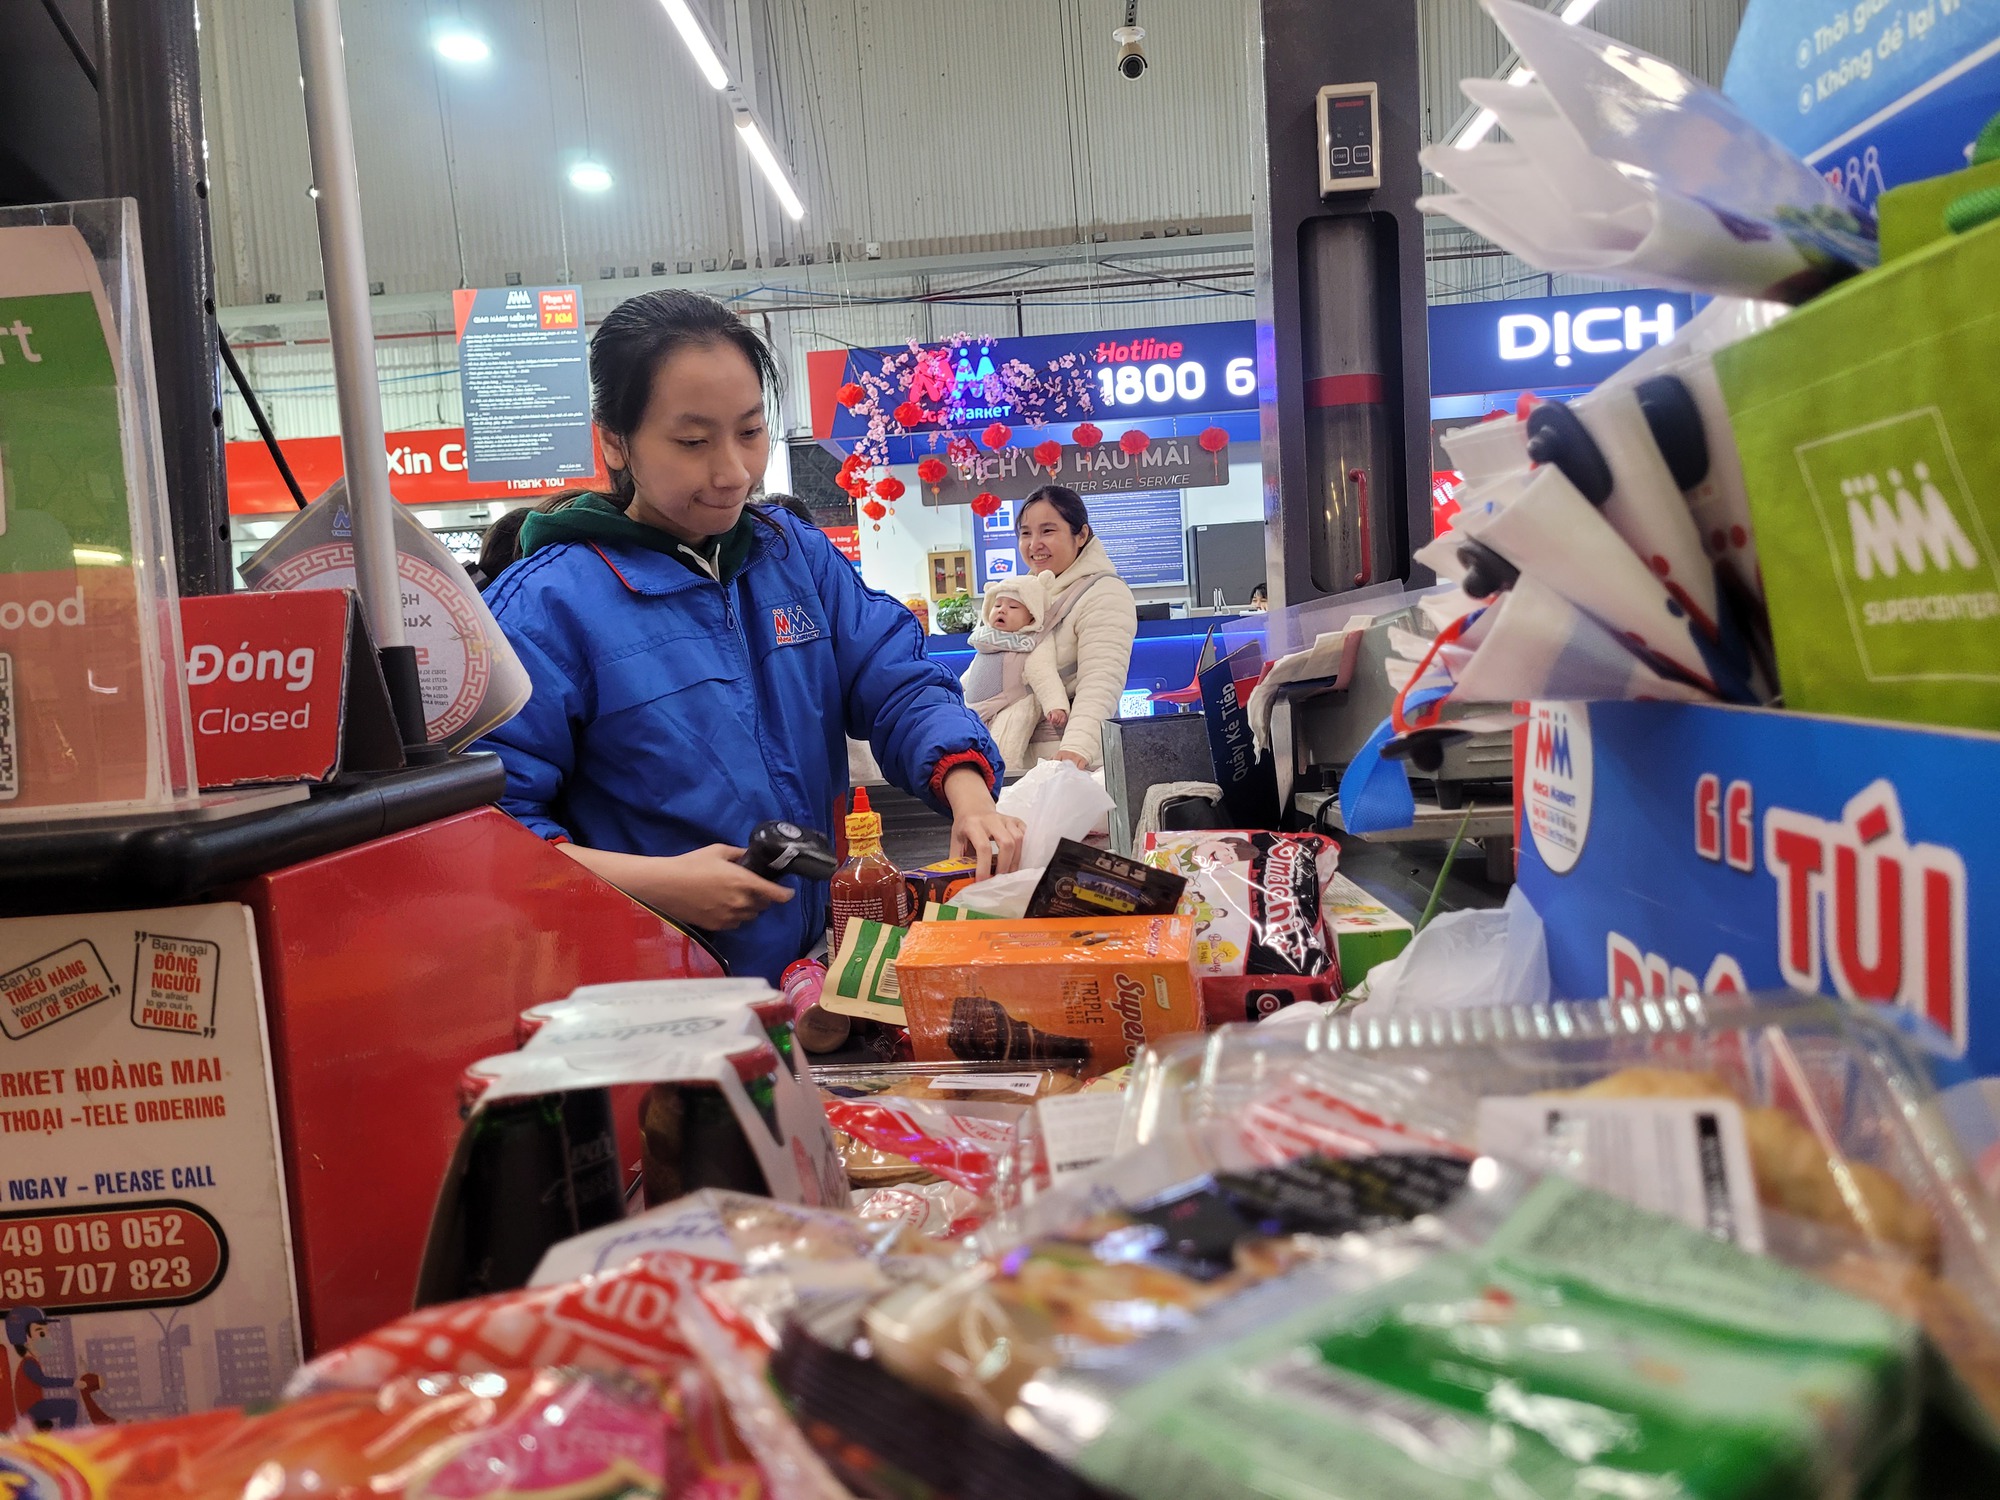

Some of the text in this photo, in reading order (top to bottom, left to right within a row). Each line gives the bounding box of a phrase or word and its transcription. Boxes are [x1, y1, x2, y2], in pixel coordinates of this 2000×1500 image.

[1816, 48, 1873, 102] Không
[544, 312, 573, 324] 7 KM
[1497, 302, 1676, 368] DỊCH
[1096, 337, 1184, 365] Hotline
[1097, 357, 1256, 407] 1800 6
[386, 446, 433, 476] Xin
[1076, 445, 1130, 476] HẬU
[1141, 440, 1190, 468] MÃI
[1102, 478, 1133, 490] SALE
[1139, 473, 1190, 488] SERVICE
[184, 641, 315, 692] Đóng
[198, 702, 311, 735] Closed
[1220, 718, 1242, 745] Kế
[1226, 744, 1248, 782] Quầy
[152, 938, 208, 957] Bạn ngại
[154, 951, 198, 974] ĐÔNG
[47, 959, 88, 988] HÀNG
[151, 971, 201, 994] NGƯỜI
[12, 978, 88, 1018] Worrying about
[20, 983, 103, 1030] OUT OF STOCK
[146, 998, 193, 1011] to go out in
[151, 989, 188, 1002] Be afraid
[1082, 980, 1104, 1025] TRIPLE
[142, 1007, 198, 1030] PUBLIC
[0, 1057, 222, 1098] RKET HOÀNG MAI
[1, 1107, 64, 1136] THOẠI
[134, 1095, 227, 1124] ORDERING
[8, 1176, 68, 1201] NGAY
[94, 1169, 165, 1195] PLEASE
[171, 1165, 216, 1190] CALL
[53, 1220, 111, 1254] 016
[121, 1214, 185, 1249] 052
[0, 1256, 192, 1300] 35 707 823
